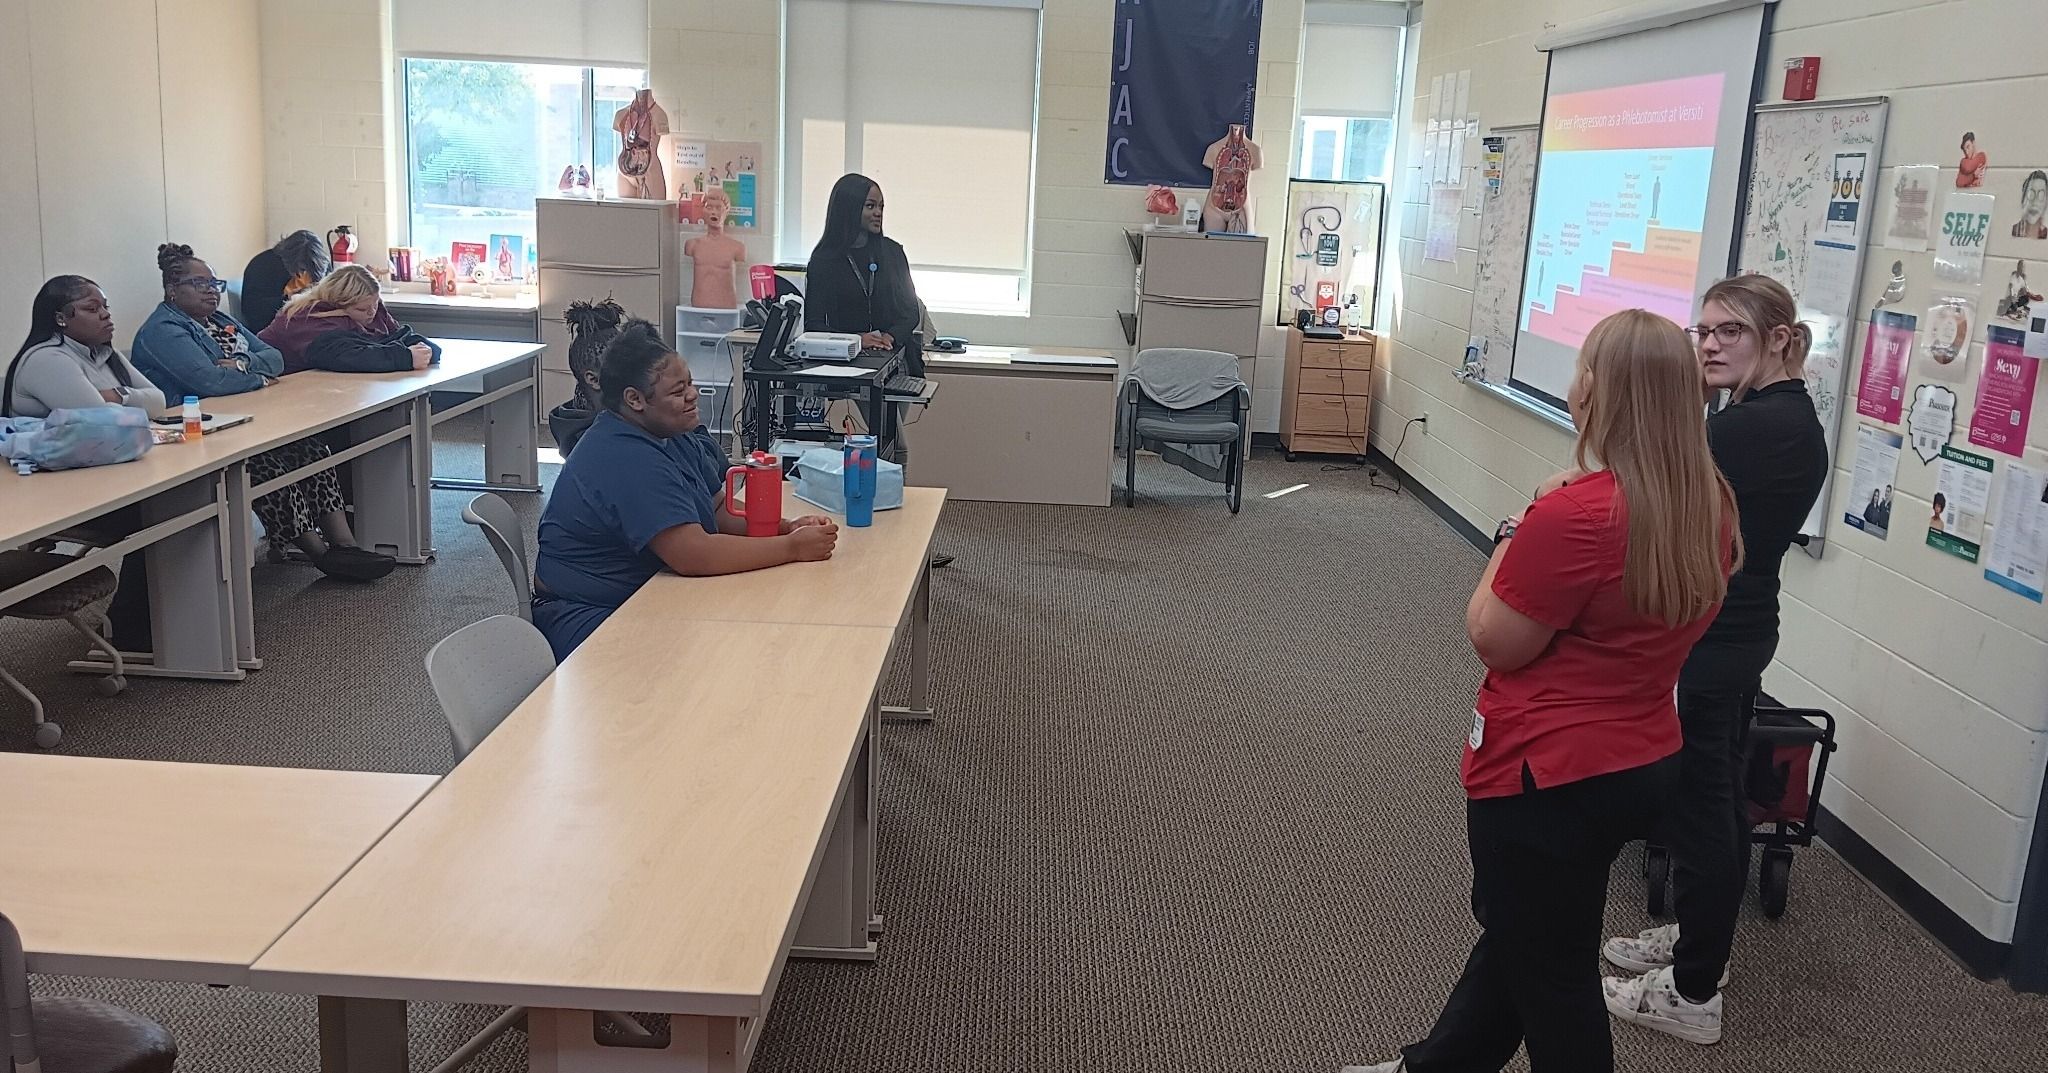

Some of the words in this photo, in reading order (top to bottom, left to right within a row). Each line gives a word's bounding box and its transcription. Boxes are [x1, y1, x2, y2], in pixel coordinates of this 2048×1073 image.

[1247, 40, 1256, 56] JOB
[1111, 0, 1141, 178] JAC
[1806, 66, 1815, 91] FIRE
[1243, 82, 1253, 127] APPRENTICES
[1574, 114, 1607, 131] Progression
[1607, 116, 1615, 127] as
[1616, 114, 1621, 126] a
[1622, 108, 1667, 126] Phlebotomist
[1668, 106, 1677, 122] at
[1942, 211, 1990, 236] SELF
[1993, 358, 2021, 379] Sexy
[1946, 449, 1964, 461] TUITION
[1964, 455, 1976, 465] AND
[1976, 458, 1988, 468] FEES
